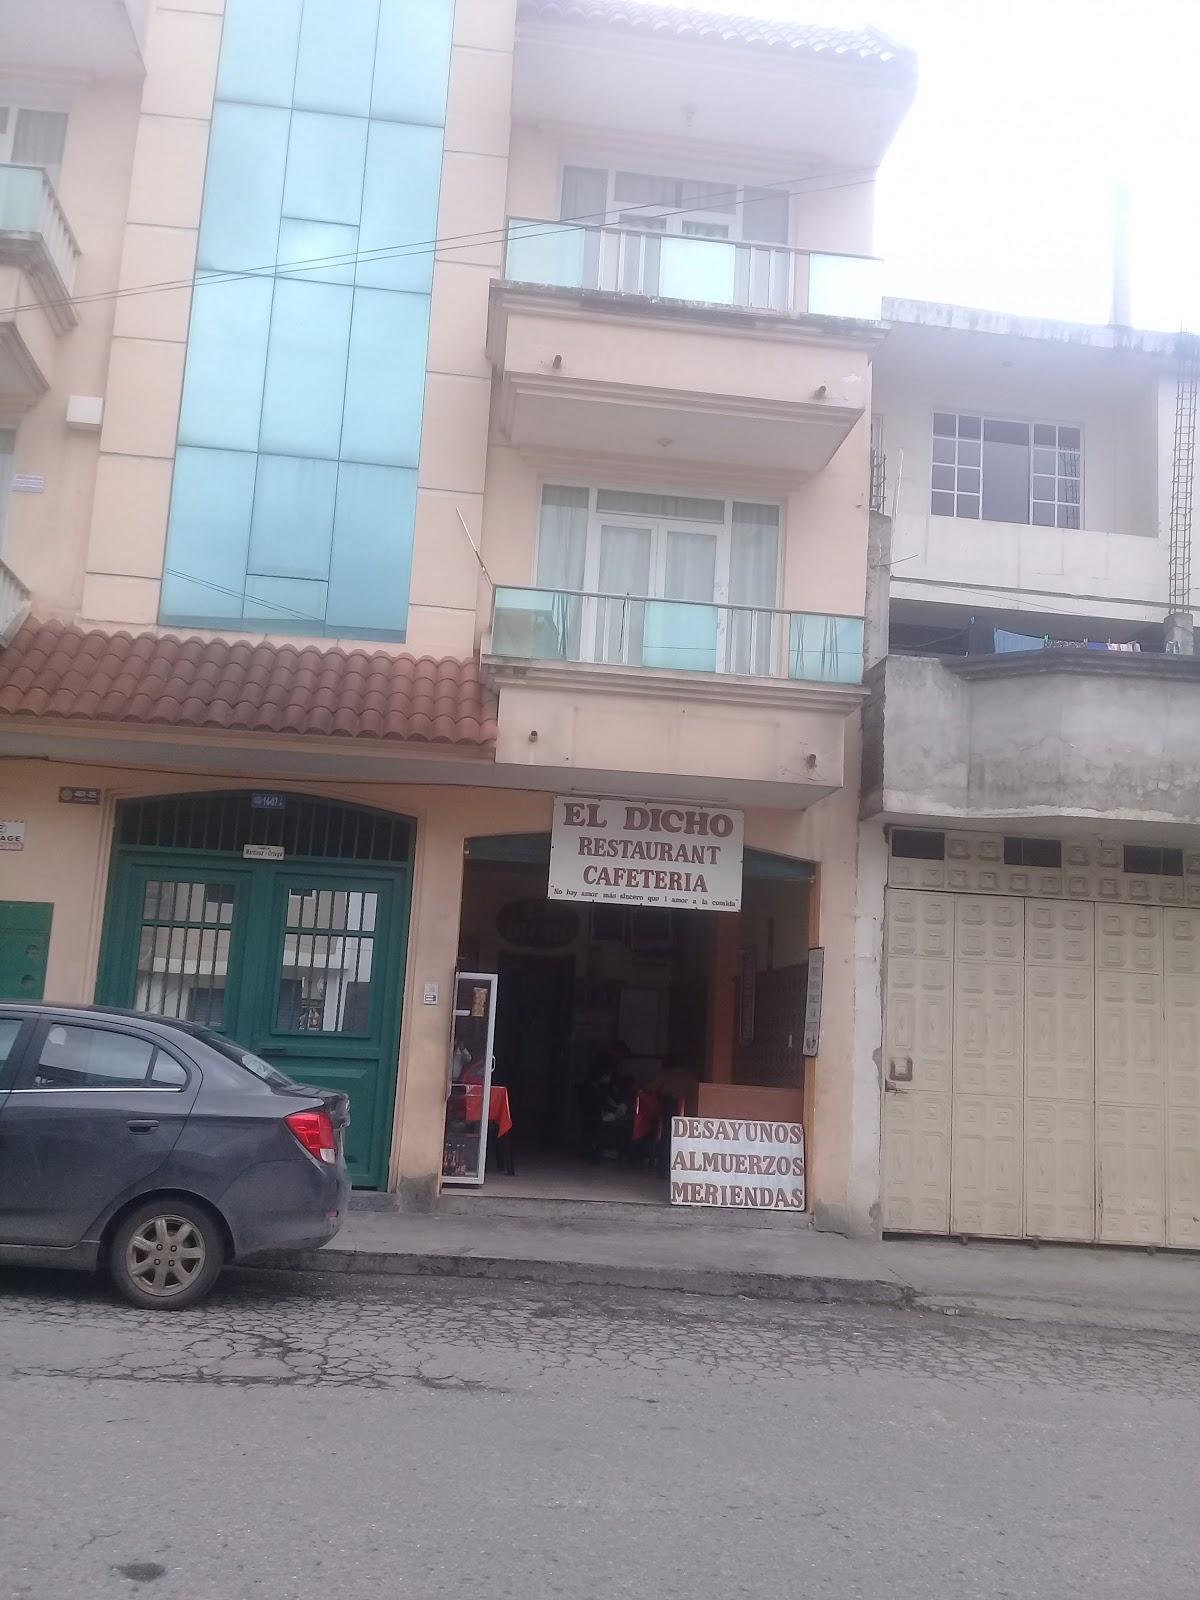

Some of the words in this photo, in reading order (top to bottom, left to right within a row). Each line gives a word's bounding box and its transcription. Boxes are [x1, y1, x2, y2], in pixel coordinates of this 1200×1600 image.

[563, 803, 607, 828] EL
[623, 806, 733, 837] DICHO
[578, 836, 721, 865] RESTAURANT
[583, 865, 708, 893] CAFETERIA
[566, 888, 578, 897] hay
[619, 892, 644, 901] sincero
[647, 895, 660, 903] que
[673, 1118, 803, 1144] DESAYUNOS
[672, 1150, 803, 1177] ALMUERZOS
[672, 1181, 803, 1208] MERIENDAS
